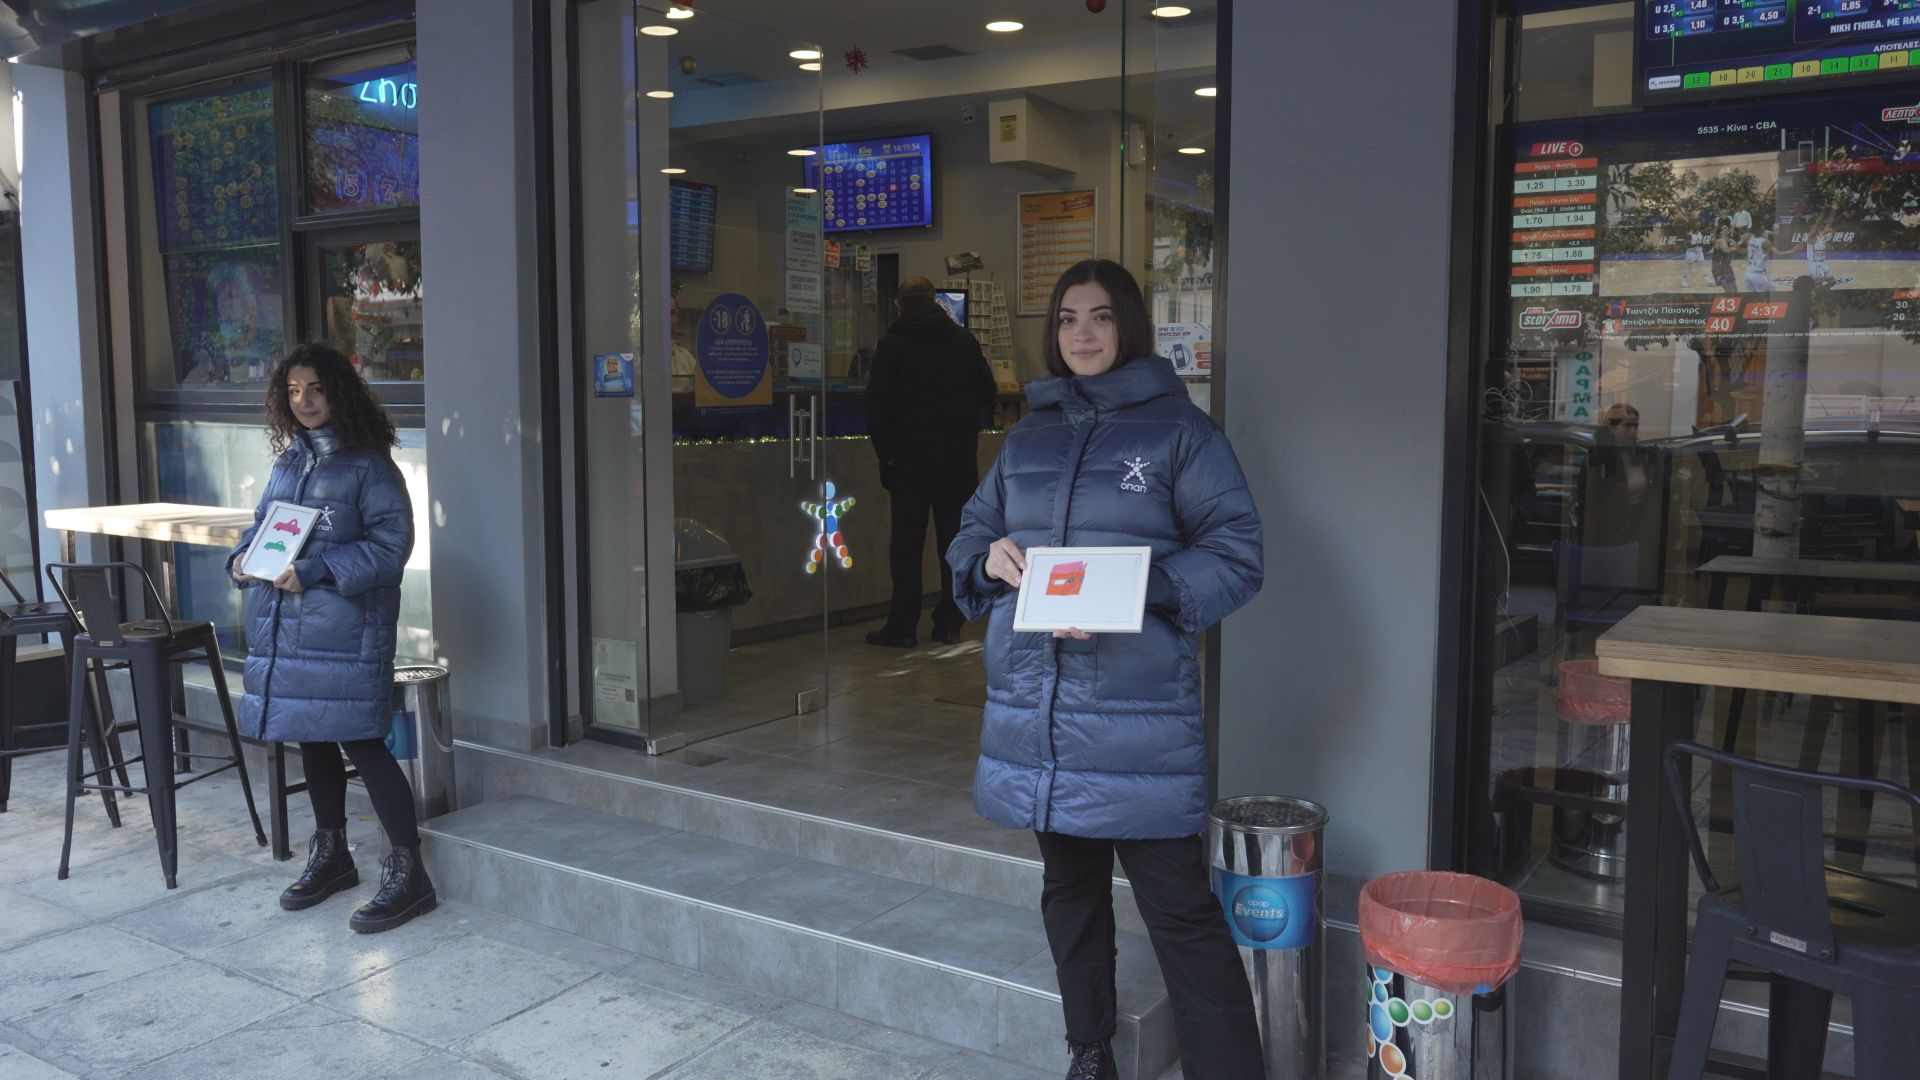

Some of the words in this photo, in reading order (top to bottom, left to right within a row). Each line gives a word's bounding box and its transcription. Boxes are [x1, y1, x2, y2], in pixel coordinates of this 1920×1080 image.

[1663, 4, 1676, 14] 2,5
[1690, 0, 1707, 10] 1,48
[1808, 5, 1821, 15] 2-1
[1841, 1, 1861, 11] 8,85
[1731, 15, 1745, 25] 3,5
[1759, 11, 1778, 21] 4,50
[1662, 24, 1675, 33] 3,5
[1690, 20, 1705, 30] 1,10
[1830, 23, 1851, 34] ΝΙΚΗ
[1801, 65, 1811, 74] 1-0
[1697, 125, 1719, 135] 5535
[1756, 120, 1778, 131] CBA
[1541, 142, 1567, 155] LIVE
[1526, 182, 1544, 191] 1.25
[1567, 179, 1586, 188] 3.30
[1526, 216, 1544, 226] 1.70
[1567, 214, 1584, 223] 1.94
[1524, 251, 1543, 260] 1.75
[1565, 249, 1583, 259] 1.88
[1523, 286, 1541, 295] 1.90
[1564, 284, 1582, 293] 1.78
[1716, 298, 1736, 312] 43
[1895, 300, 1908, 309] 30
[1751, 305, 1778, 317] 4:37
[1892, 312, 1905, 321] 20
[1710, 319, 1730, 332] 40
[1235, 902, 1286, 920] Events
